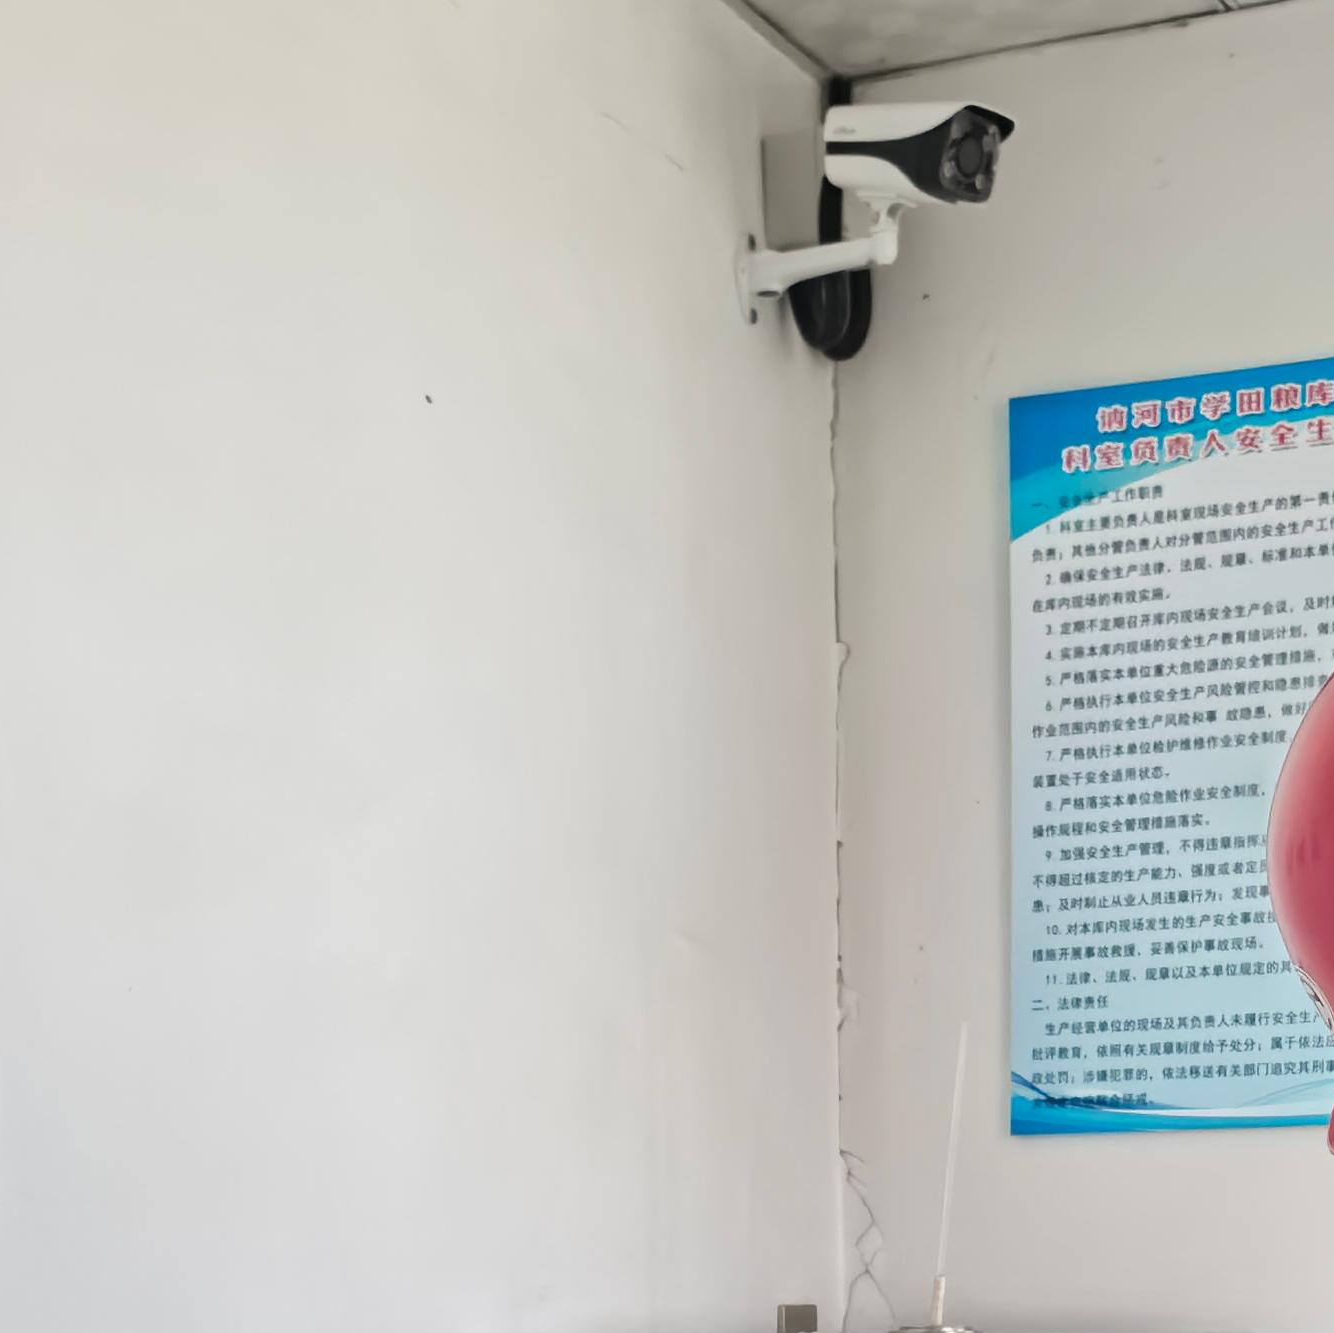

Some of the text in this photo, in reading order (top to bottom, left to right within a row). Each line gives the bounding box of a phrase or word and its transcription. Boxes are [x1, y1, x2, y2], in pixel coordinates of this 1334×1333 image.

[1032, 812, 1210, 839] 操作规程和安全管理措施落实。
[1031, 994, 1109, 1012] 二、法律责任
